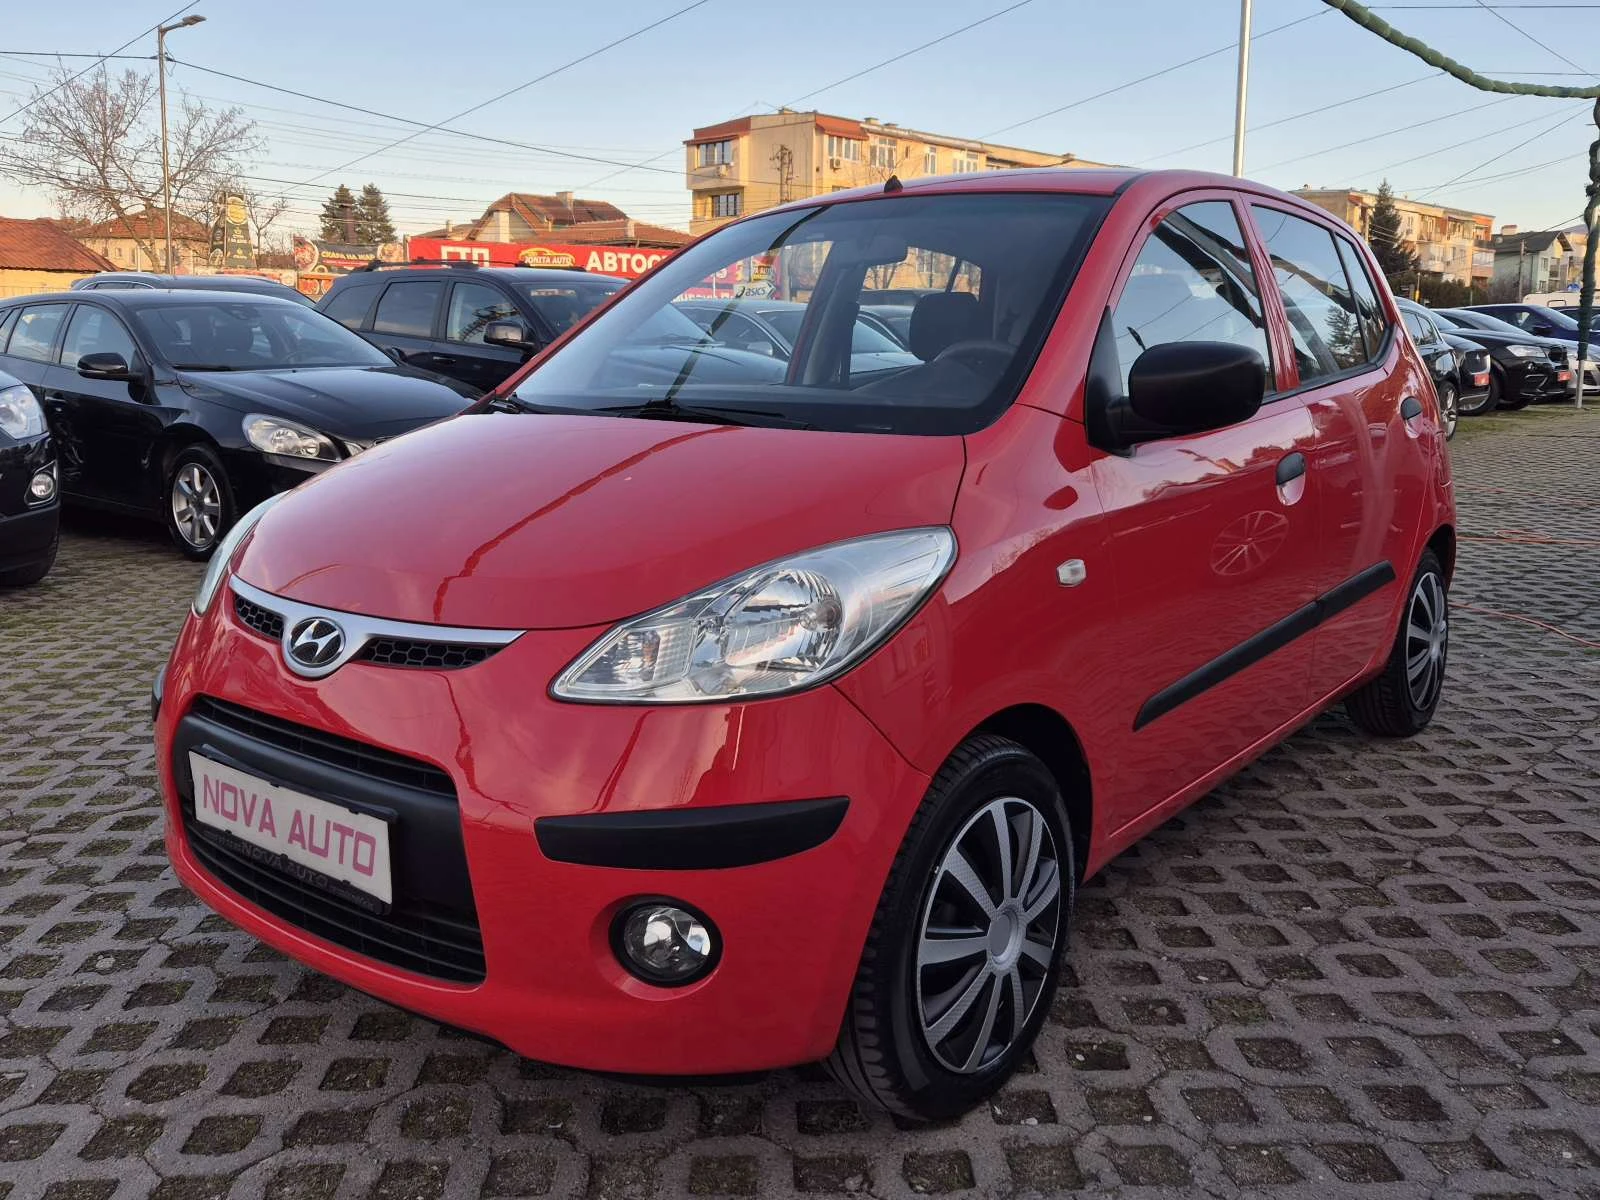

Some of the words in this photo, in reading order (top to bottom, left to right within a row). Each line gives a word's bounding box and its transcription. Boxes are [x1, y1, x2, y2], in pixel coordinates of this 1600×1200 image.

[552, 256, 572, 265] AUTO
[586, 250, 669, 274] АВТОС
[203, 773, 277, 839] NOVA
[287, 809, 377, 877] AUTO
